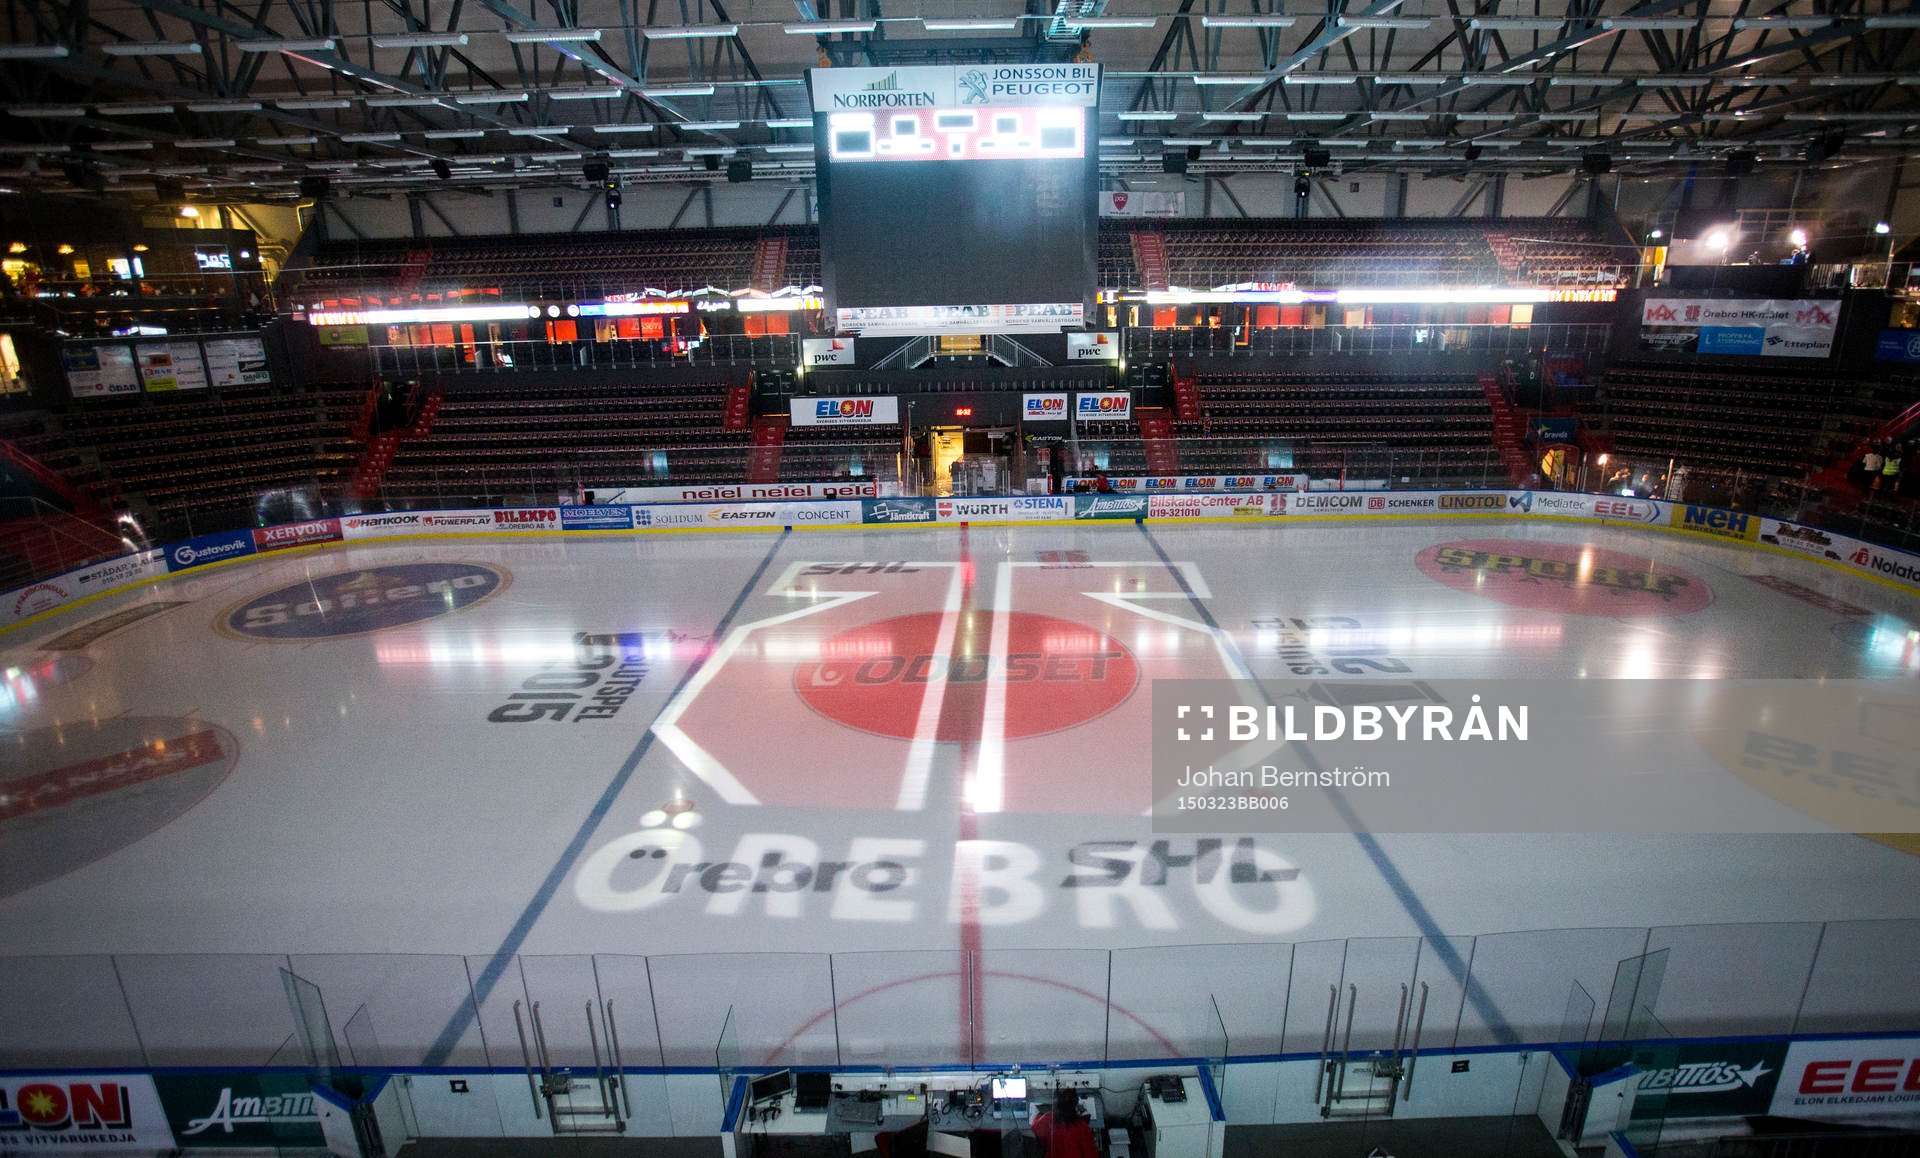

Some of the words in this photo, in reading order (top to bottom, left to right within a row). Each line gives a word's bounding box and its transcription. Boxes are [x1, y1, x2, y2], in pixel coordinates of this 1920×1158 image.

[993, 68, 1067, 80] JONSSON
[1072, 67, 1095, 79] BIL
[993, 83, 1095, 95] PEUGEOT
[834, 91, 935, 108] NORRPORTEN
[933, 306, 991, 317] PEAB
[1015, 304, 1073, 316] PEAB
[814, 353, 837, 363] pwc
[1078, 348, 1101, 358] pwc
[816, 400, 873, 417] ELON
[1027, 399, 1064, 410] ELON
[1079, 397, 1129, 412] ELON
[1145, 478, 1177, 489] ELON
[1185, 478, 1217, 488] ELON
[1224, 477, 1255, 488] ELON
[1263, 476, 1294, 487] ELON
[1025, 498, 1064, 508] STENA
[1246, 494, 1264, 506] AB
[1296, 496, 1362, 507] DEMCOM
[1370, 498, 1384, 508] DB
[1388, 499, 1434, 508] SCHENKER
[1441, 495, 1505, 508] LINOTOL
[1538, 497, 1585, 510] Mediatec
[721, 511, 776, 519] EASTON
[797, 510, 851, 520] CONCENT
[956, 503, 1008, 515] WÜRTH
[1150, 508, 1200, 517] 019-321010
[1594, 501, 1642, 518] EEL
[434, 518, 491, 526] POWERPLAY
[494, 510, 557, 523] BILEXPO
[656, 514, 703, 524] SOLIDUM
[889, 510, 930, 522] Jämtkraft
[265, 522, 328, 540] XERVON
[175, 539, 246, 565] Gustavsvik
[800, 562, 921, 576] SHL
[854, 652, 1124, 686] ODDSET
[1060, 837, 1300, 888] SHL
[575, 810, 1318, 935] ÖREBRO
[1794, 1097, 1824, 1105] ELON
[1827, 1095, 1885, 1104] ELKEDJAN
[25, 1133, 136, 1145] VITVARUKEDJA
